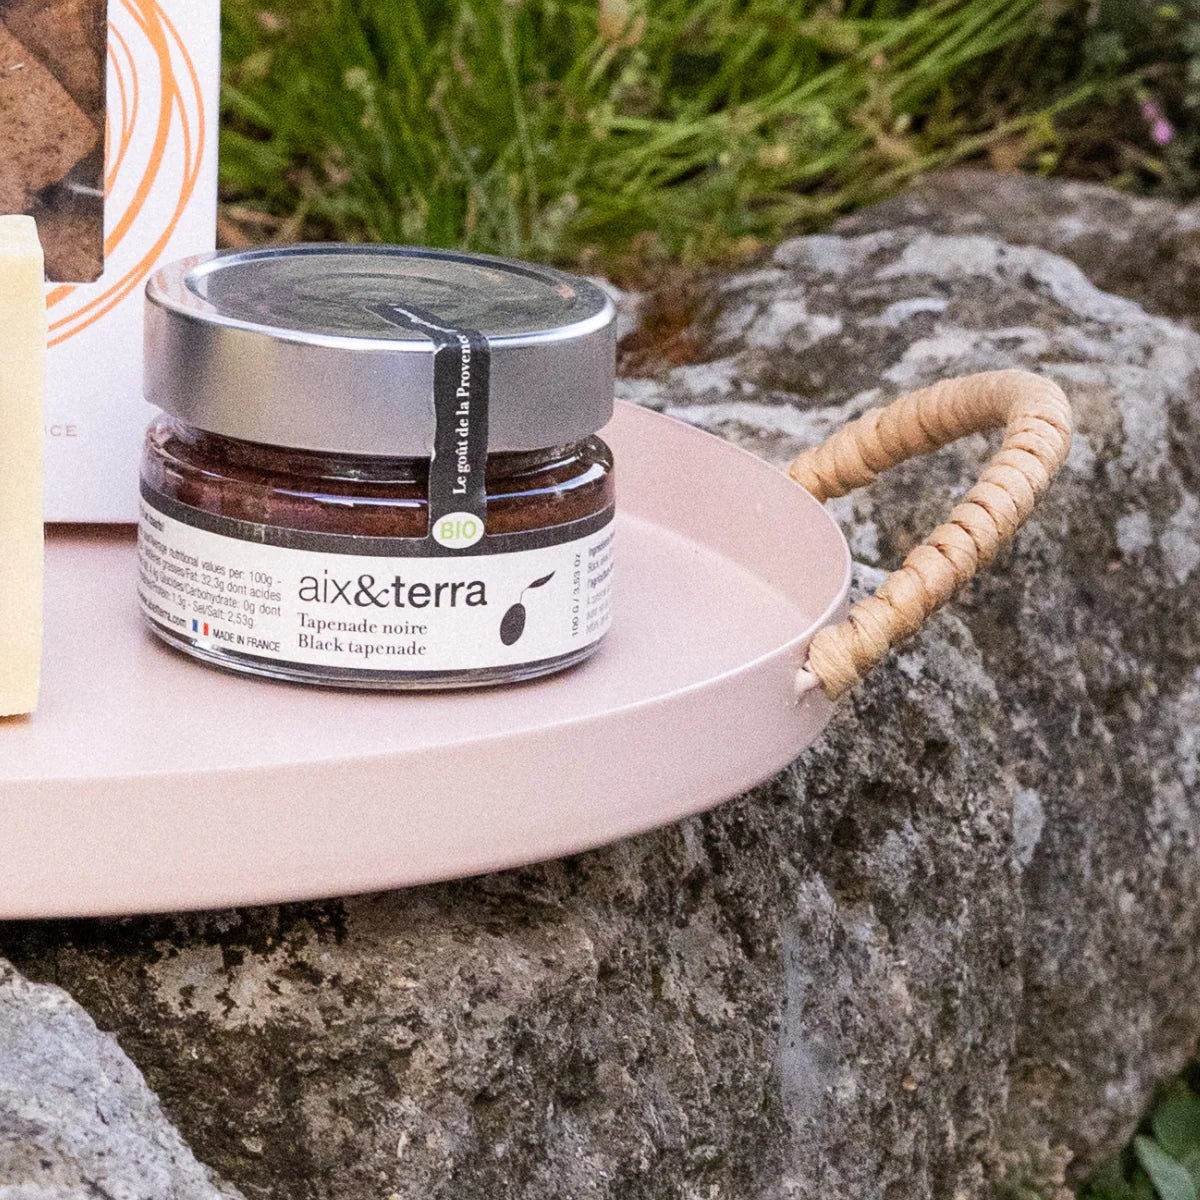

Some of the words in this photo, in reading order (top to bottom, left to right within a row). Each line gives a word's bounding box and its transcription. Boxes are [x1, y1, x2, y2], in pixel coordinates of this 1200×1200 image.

[456, 401, 470, 415] la
[456, 417, 470, 437] de
[456, 439, 471, 474] goût
[453, 474, 467, 495] Le
[440, 519, 477, 540] BIO
[201, 560, 226, 577] values
[249, 571, 273, 588] 100g
[227, 581, 247, 595] dont
[249, 586, 282, 602] acides
[298, 569, 488, 609] aix&terra
[259, 603, 281, 617] dont
[297, 612, 377, 634] Tapenade
[382, 621, 428, 635] noire
[212, 628, 235, 644] MADE
[236, 632, 245, 646] IN
[246, 636, 281, 652] FRANCE
[298, 634, 344, 652] Black
[349, 641, 427, 659] tapenade
